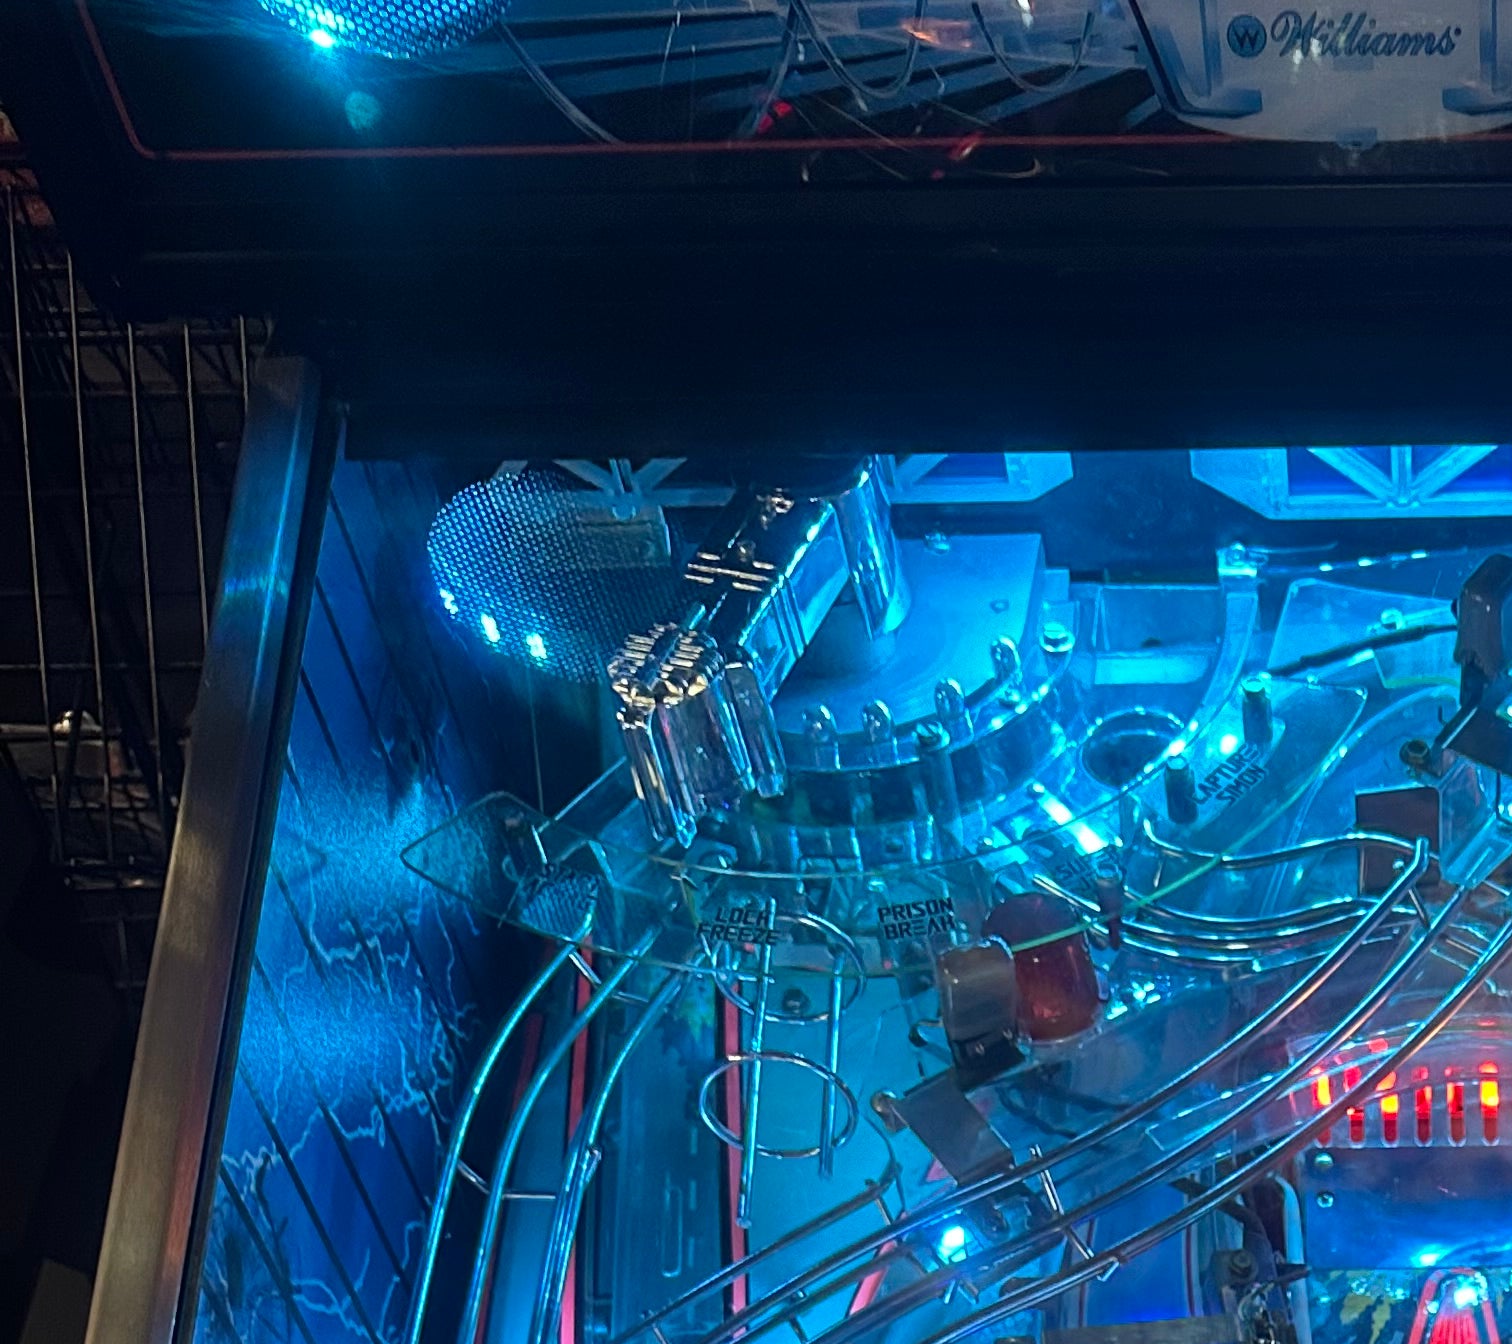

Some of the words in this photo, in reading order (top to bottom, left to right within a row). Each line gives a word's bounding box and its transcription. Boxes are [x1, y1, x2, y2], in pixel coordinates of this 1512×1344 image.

[1270, 10, 1457, 58] Williams
[1193, 744, 1259, 804] CAPTURE
[1215, 764, 1267, 806] SIMON
[715, 906, 770, 926] LOCK
[877, 897, 953, 923] PRISON
[696, 922, 782, 945] FREEZE
[883, 912, 956, 940] BREAK
